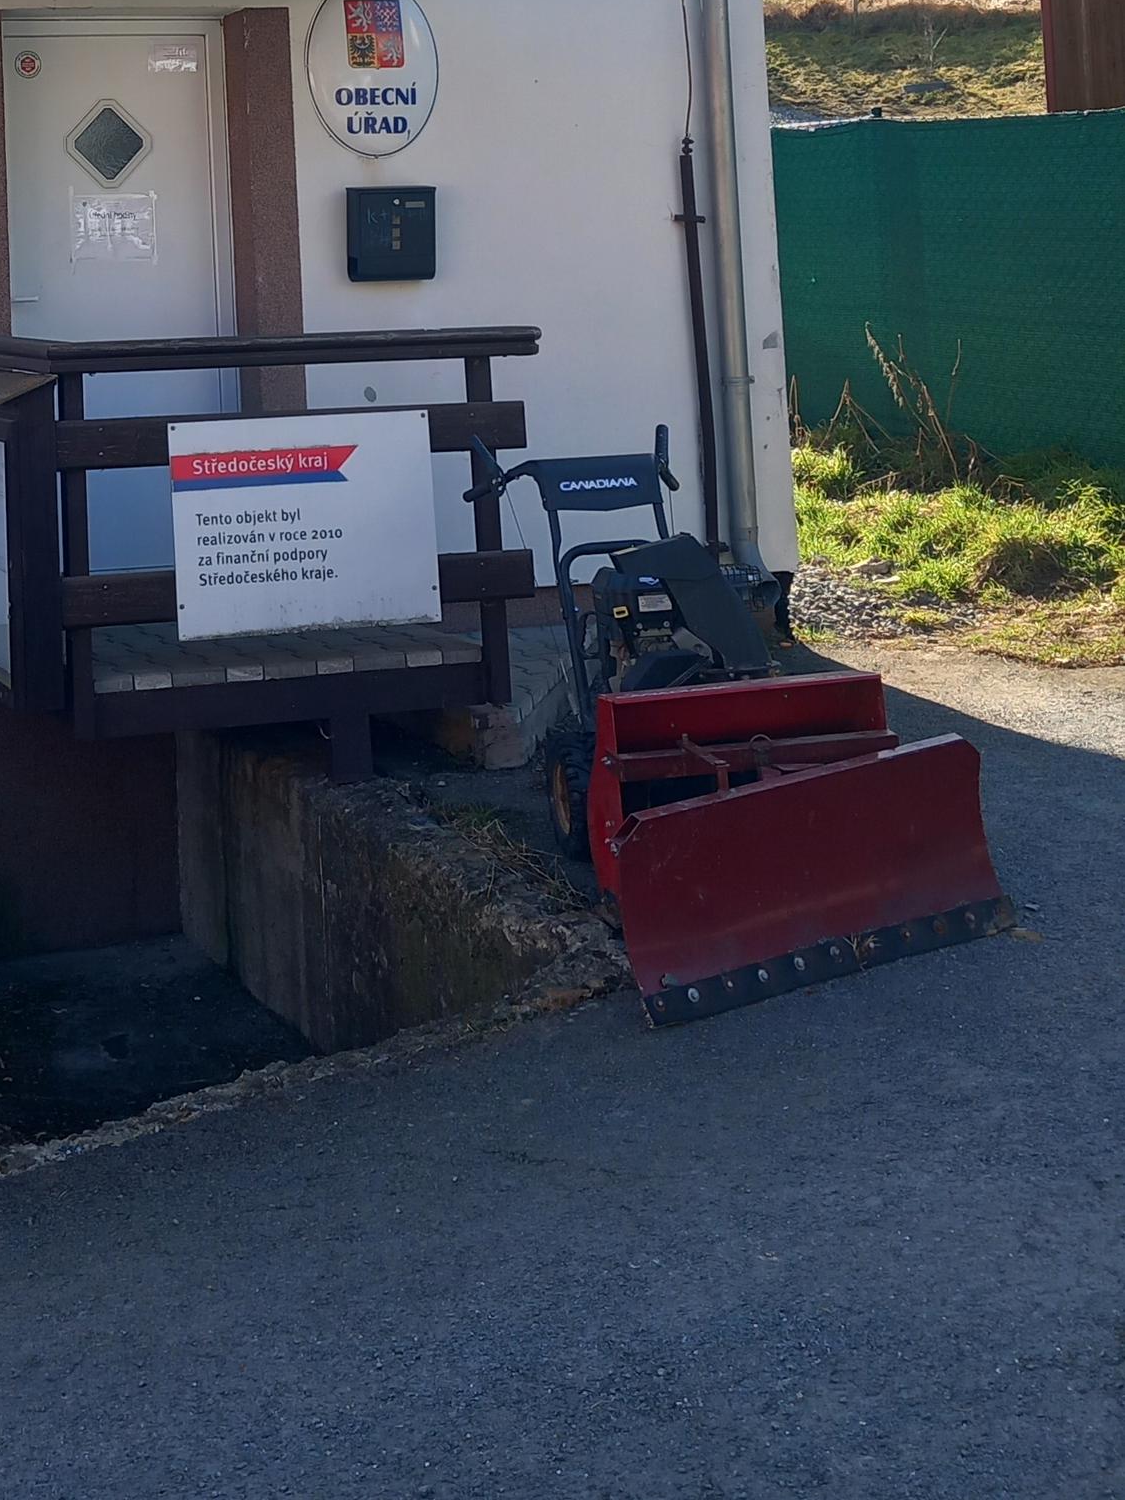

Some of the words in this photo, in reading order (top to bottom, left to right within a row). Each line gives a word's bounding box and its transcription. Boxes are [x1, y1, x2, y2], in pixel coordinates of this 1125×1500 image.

[335, 82, 417, 106] OBECNÍ
[347, 111, 408, 134] ÚŘAD
[192, 454, 295, 475] Středočeský
[299, 452, 328, 470] kraj
[559, 477, 638, 491] CANADIANA
[195, 513, 232, 526] Tento
[236, 510, 278, 526] objekt
[281, 508, 301, 525] byl
[197, 531, 265, 546] realizován
[269, 532, 275, 542] v
[279, 530, 307, 542] roce
[311, 529, 343, 540] 2010
[197, 556, 213, 567] za
[216, 549, 270, 565] finanční
[273, 547, 328, 564] podpory
[199, 569, 298, 587] Středočeského
[301, 567, 339, 582] kraje.
